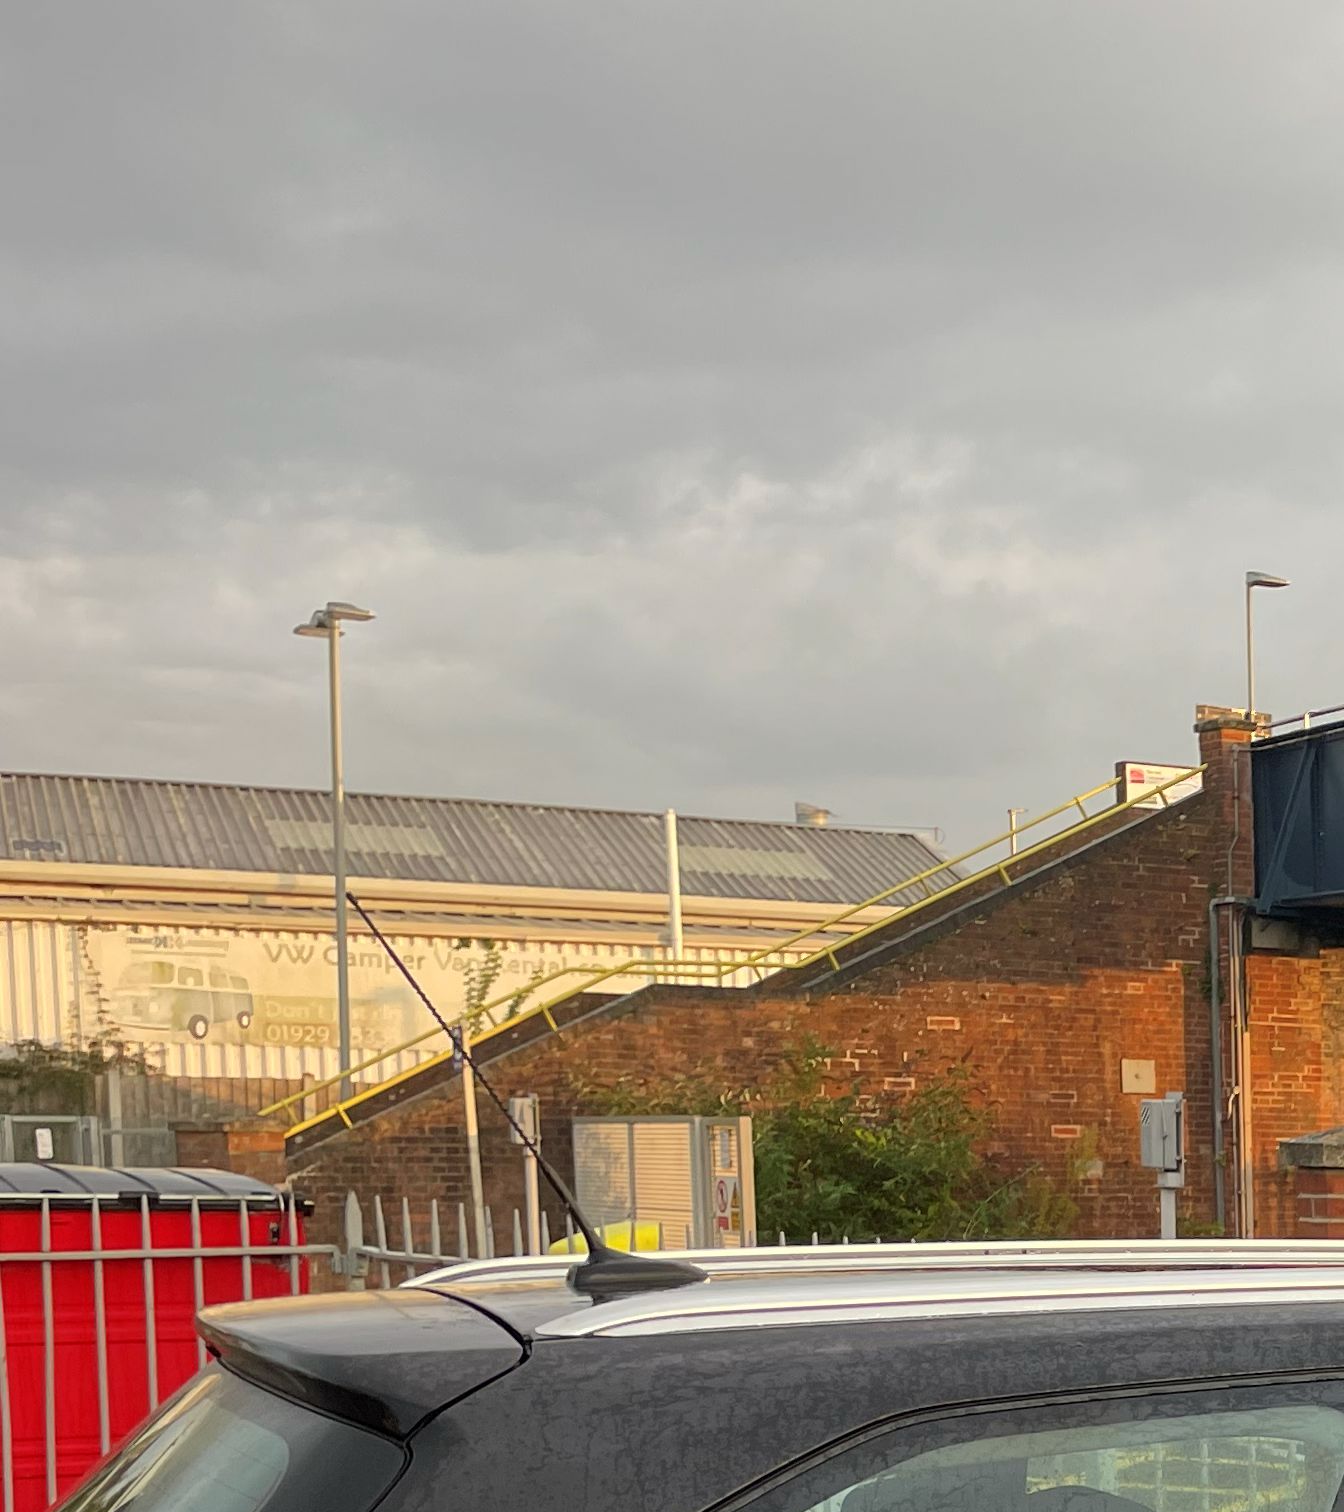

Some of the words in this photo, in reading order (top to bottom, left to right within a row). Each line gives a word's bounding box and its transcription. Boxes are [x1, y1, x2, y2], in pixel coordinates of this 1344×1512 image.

[263, 943, 314, 964] VW
[323, 945, 426, 974] Camper
[266, 1025, 330, 1043] 01929
